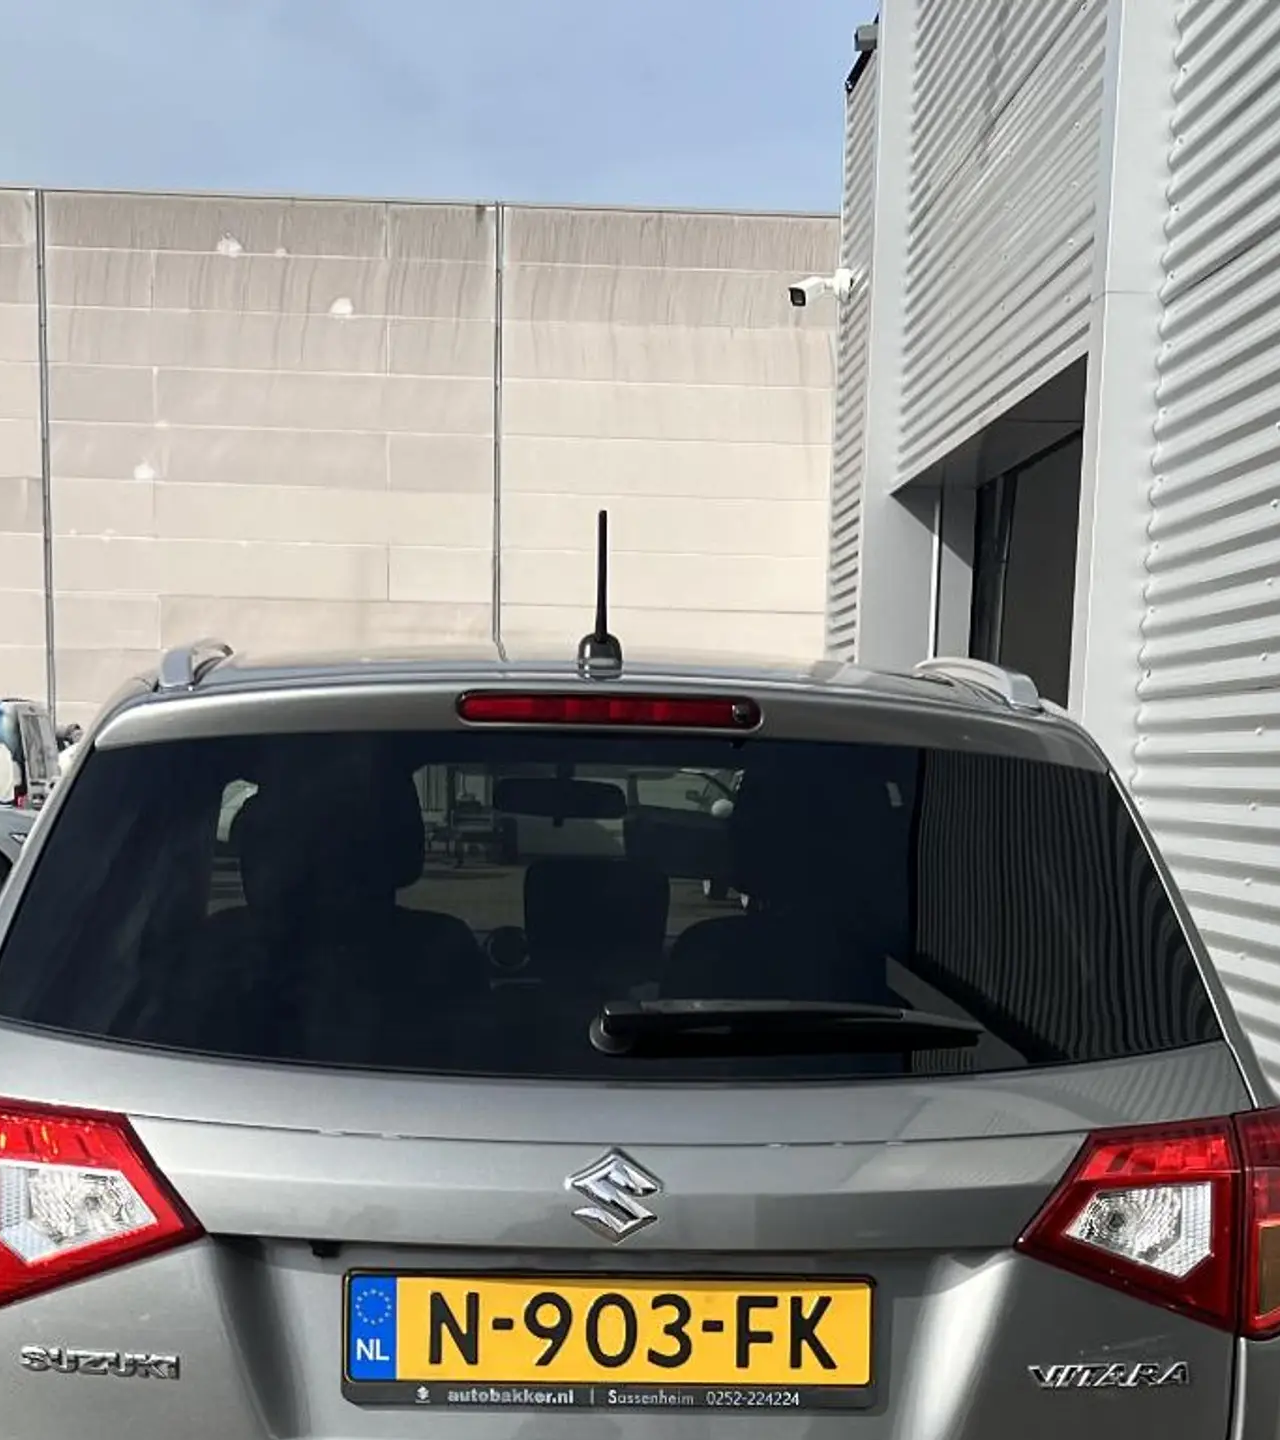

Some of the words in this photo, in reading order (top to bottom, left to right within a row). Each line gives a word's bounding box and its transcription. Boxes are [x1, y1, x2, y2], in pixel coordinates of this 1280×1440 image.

[428, 1291, 838, 1370] N-903-FK
[356, 1338, 390, 1361] NL
[21, 1346, 180, 1380] SUZUKI
[1027, 1361, 1189, 1387] VITARA
[447, 1388, 574, 1404] autobakker.nl
[706, 1391, 800, 1406] 0252-224224
